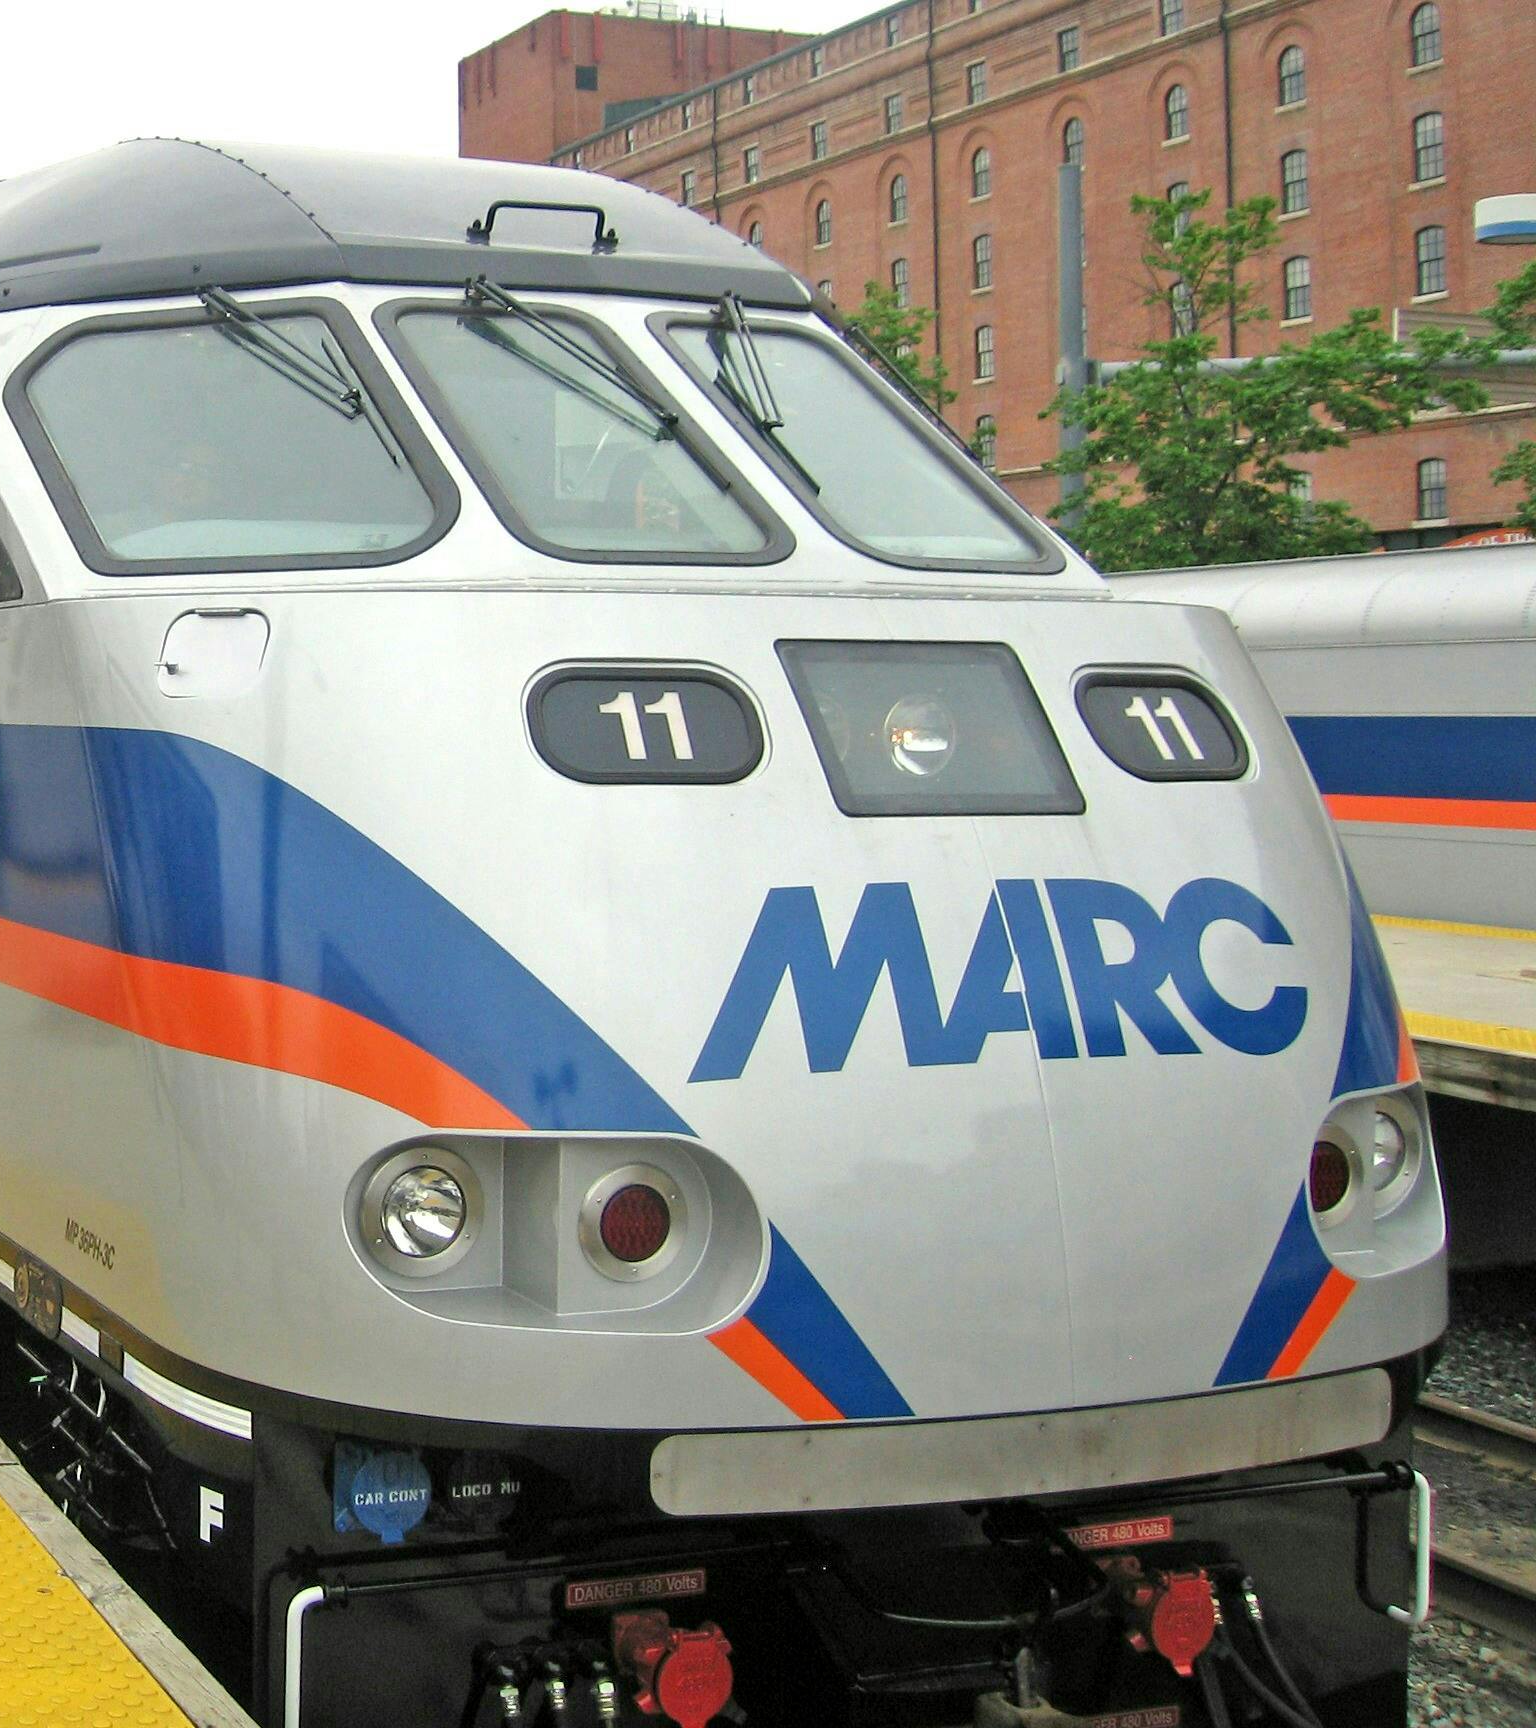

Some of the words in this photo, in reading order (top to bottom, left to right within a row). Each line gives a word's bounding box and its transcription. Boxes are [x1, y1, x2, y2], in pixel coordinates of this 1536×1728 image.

[598, 690, 695, 761] 11
[1123, 695, 1205, 761] 11
[686, 876, 1310, 1084] MARC
[354, 1491, 384, 1506] CAR
[388, 1488, 428, 1504] CONT
[452, 1482, 492, 1499] LOCO
[199, 1485, 225, 1543] F
[1069, 1527, 1109, 1545] NGER
[1112, 1525, 1134, 1540] 480
[1137, 1522, 1165, 1537] Volts
[573, 1581, 634, 1602] DANGER
[638, 1578, 662, 1595] 480
[666, 1574, 698, 1591] Volts
